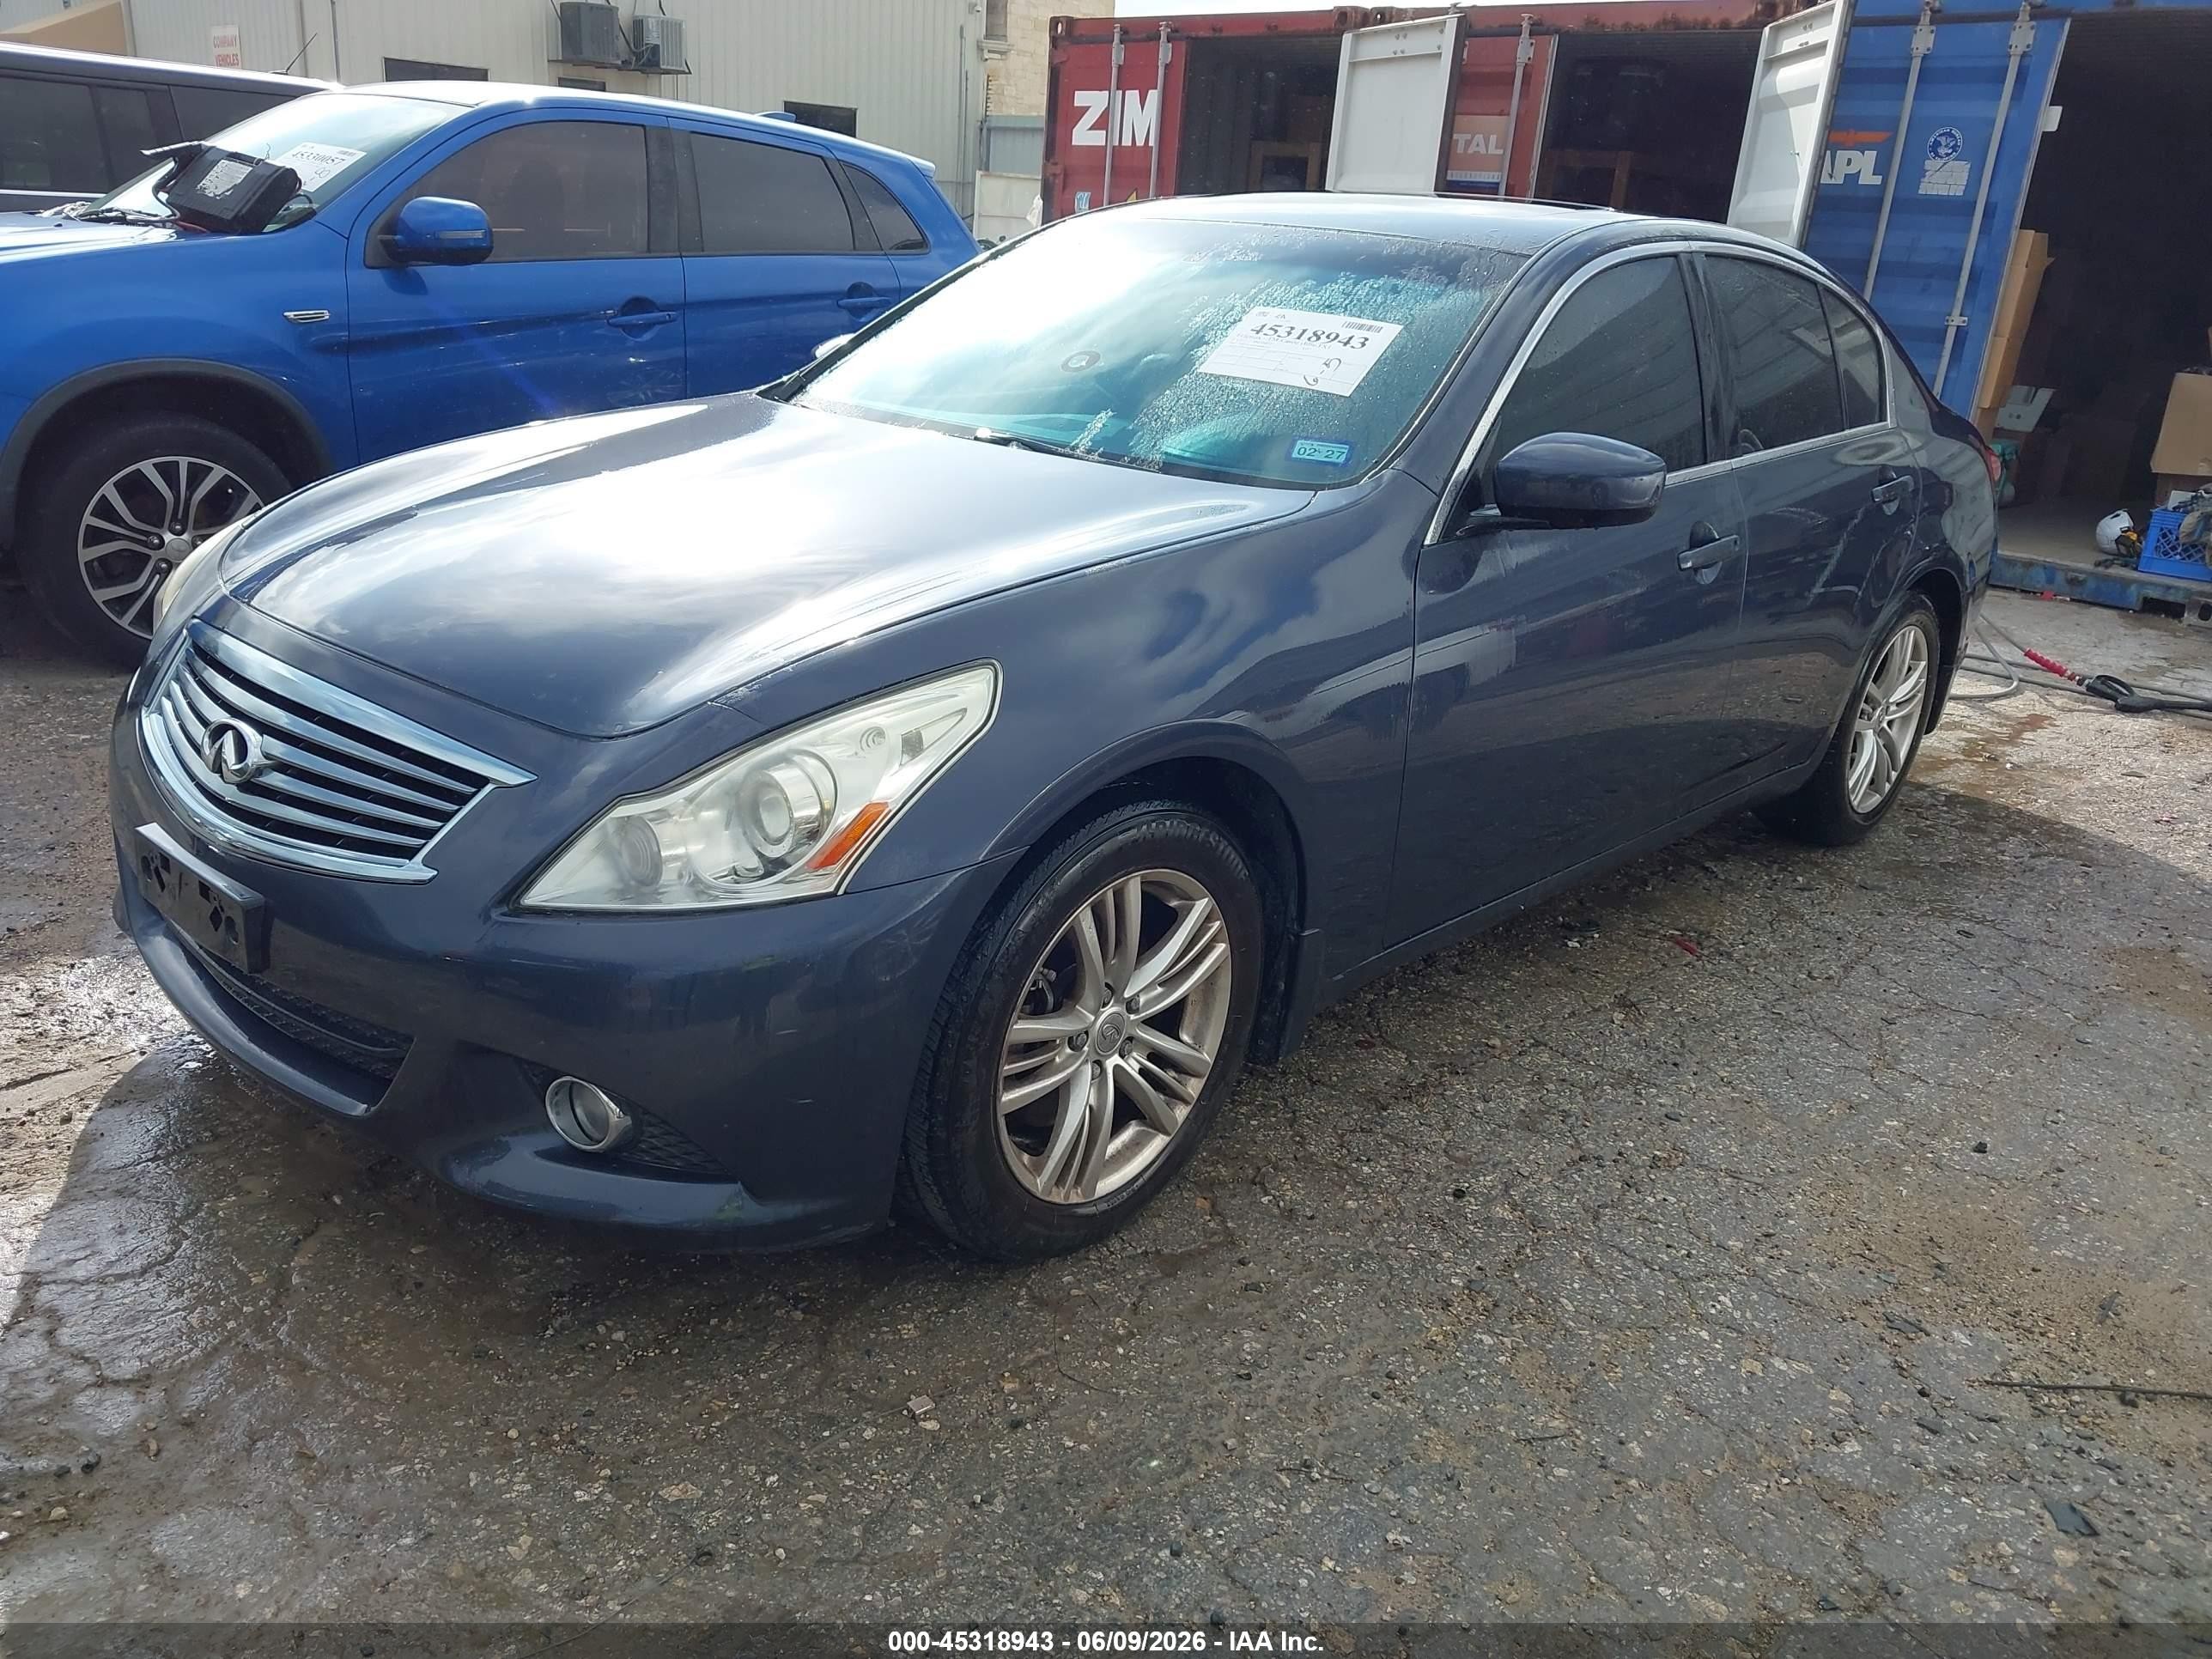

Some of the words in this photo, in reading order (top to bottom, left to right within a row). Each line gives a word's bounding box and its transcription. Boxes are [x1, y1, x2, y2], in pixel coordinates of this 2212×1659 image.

[215, 52, 240, 68] VEHICLES
[1072, 89, 1159, 146] ZIM
[1453, 133, 1504, 155] TAL
[1250, 322, 1370, 349] 45318943
[1297, 447, 1317, 457] 02
[1323, 449, 1346, 459] 27
